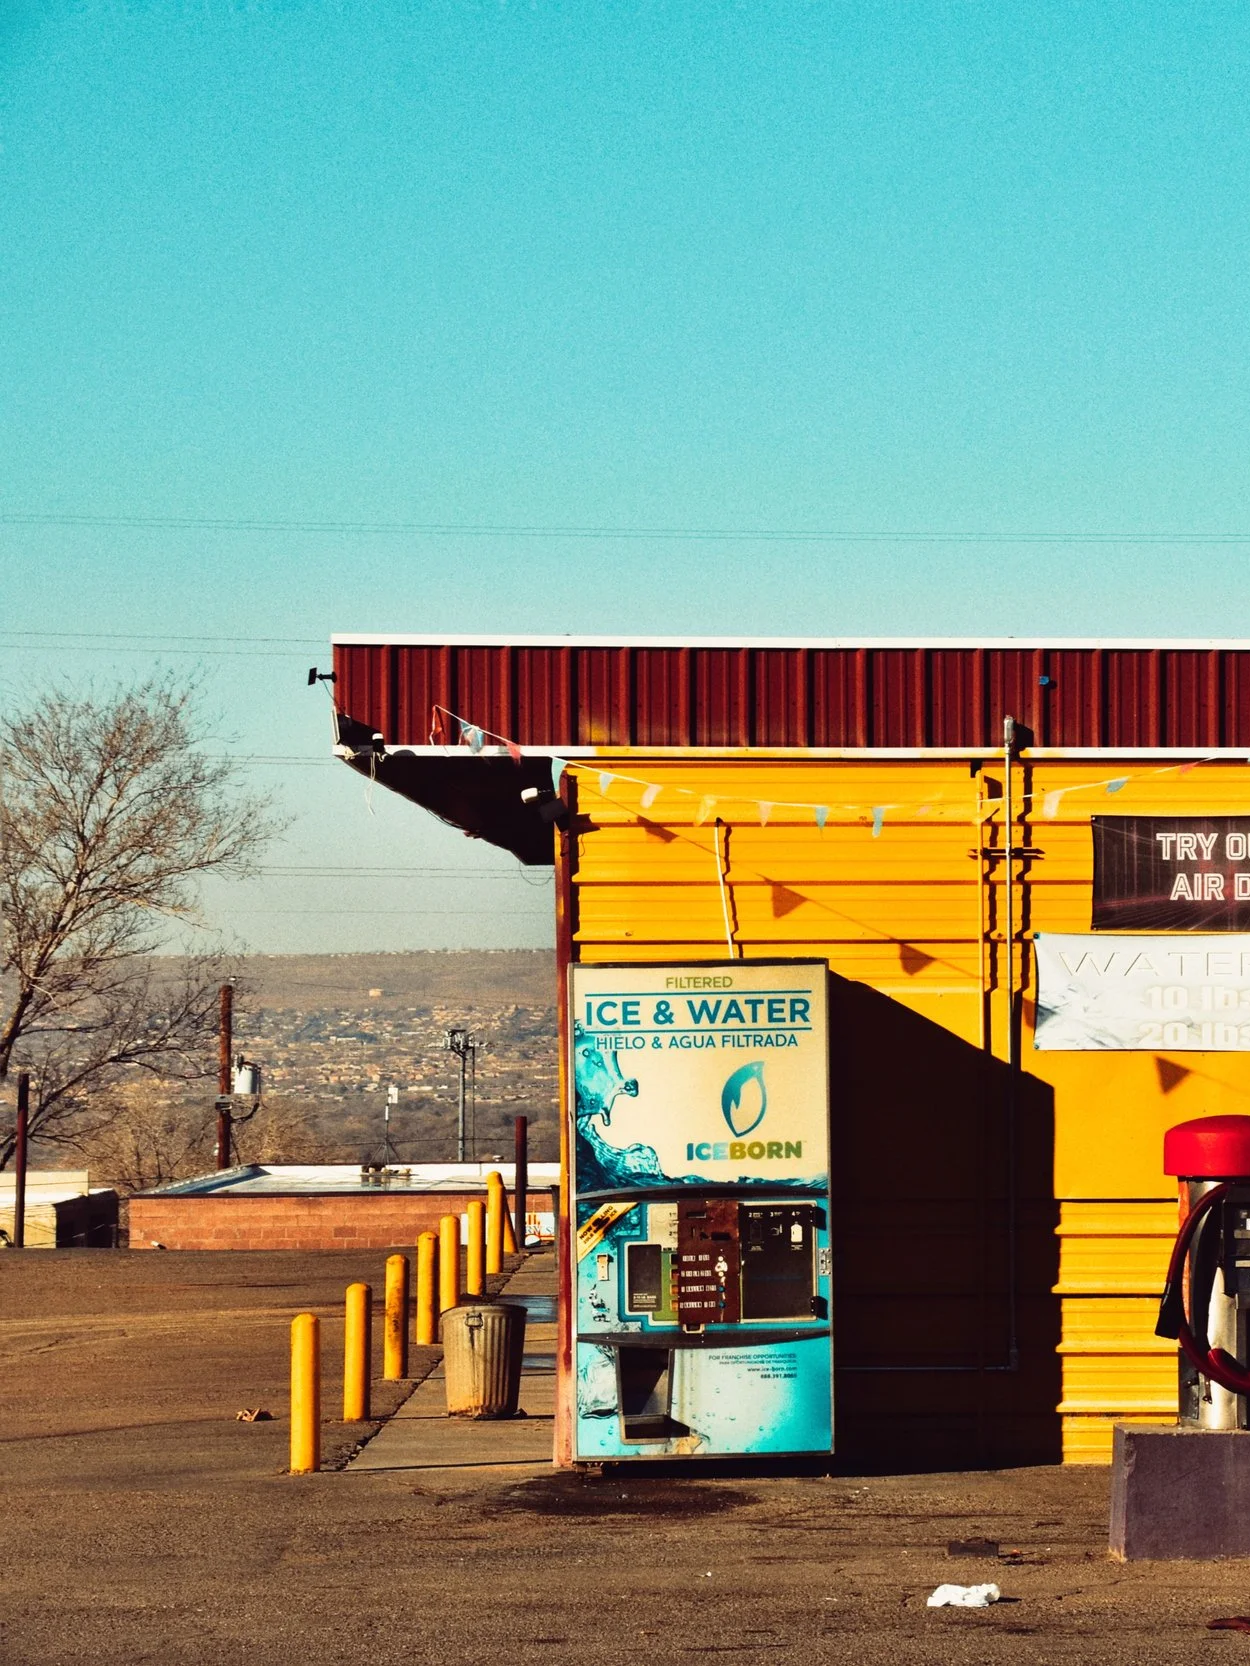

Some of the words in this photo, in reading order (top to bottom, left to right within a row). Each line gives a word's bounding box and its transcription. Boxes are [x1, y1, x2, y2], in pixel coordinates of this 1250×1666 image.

[1156, 832, 1219, 861] TRY
[1170, 872, 1225, 901] AIR
[665, 976, 733, 989] FILTERED
[1147, 986, 1189, 1010] 10
[585, 1000, 641, 1026] ICE
[653, 1000, 675, 1025] &
[686, 998, 811, 1025] WATER
[596, 1036, 646, 1050] HIELO
[651, 1036, 663, 1049] &
[668, 1035, 716, 1049] AGUA
[721, 1034, 798, 1048] FILTRADA
[1139, 1022, 1188, 1047] 20
[686, 1140, 803, 1161] ICEBORN
